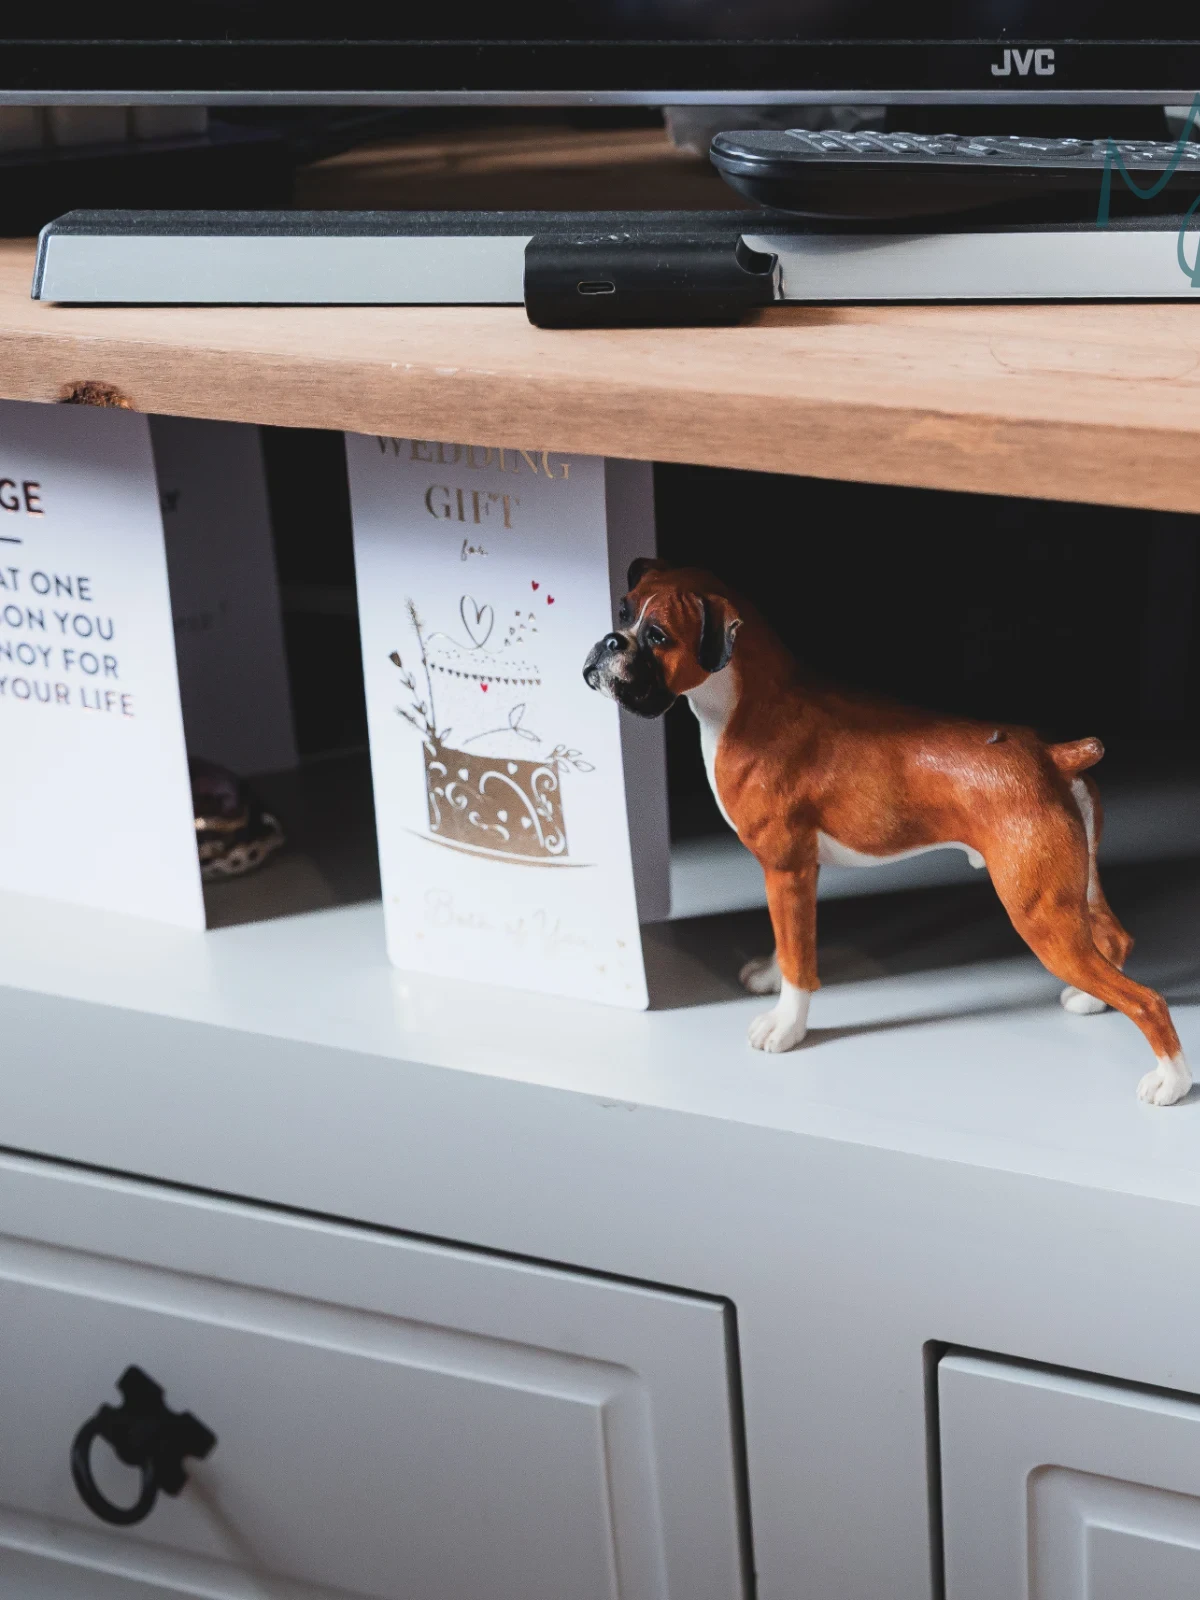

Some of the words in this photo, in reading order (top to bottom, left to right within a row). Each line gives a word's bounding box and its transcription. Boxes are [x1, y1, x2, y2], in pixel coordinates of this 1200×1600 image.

[991, 49, 1055, 75] JVC
[424, 484, 520, 529] GIFT
[30, 571, 92, 601] ONE
[53, 609, 113, 641] YOU
[63, 648, 119, 679] FOR
[81, 687, 135, 717] LIFE
